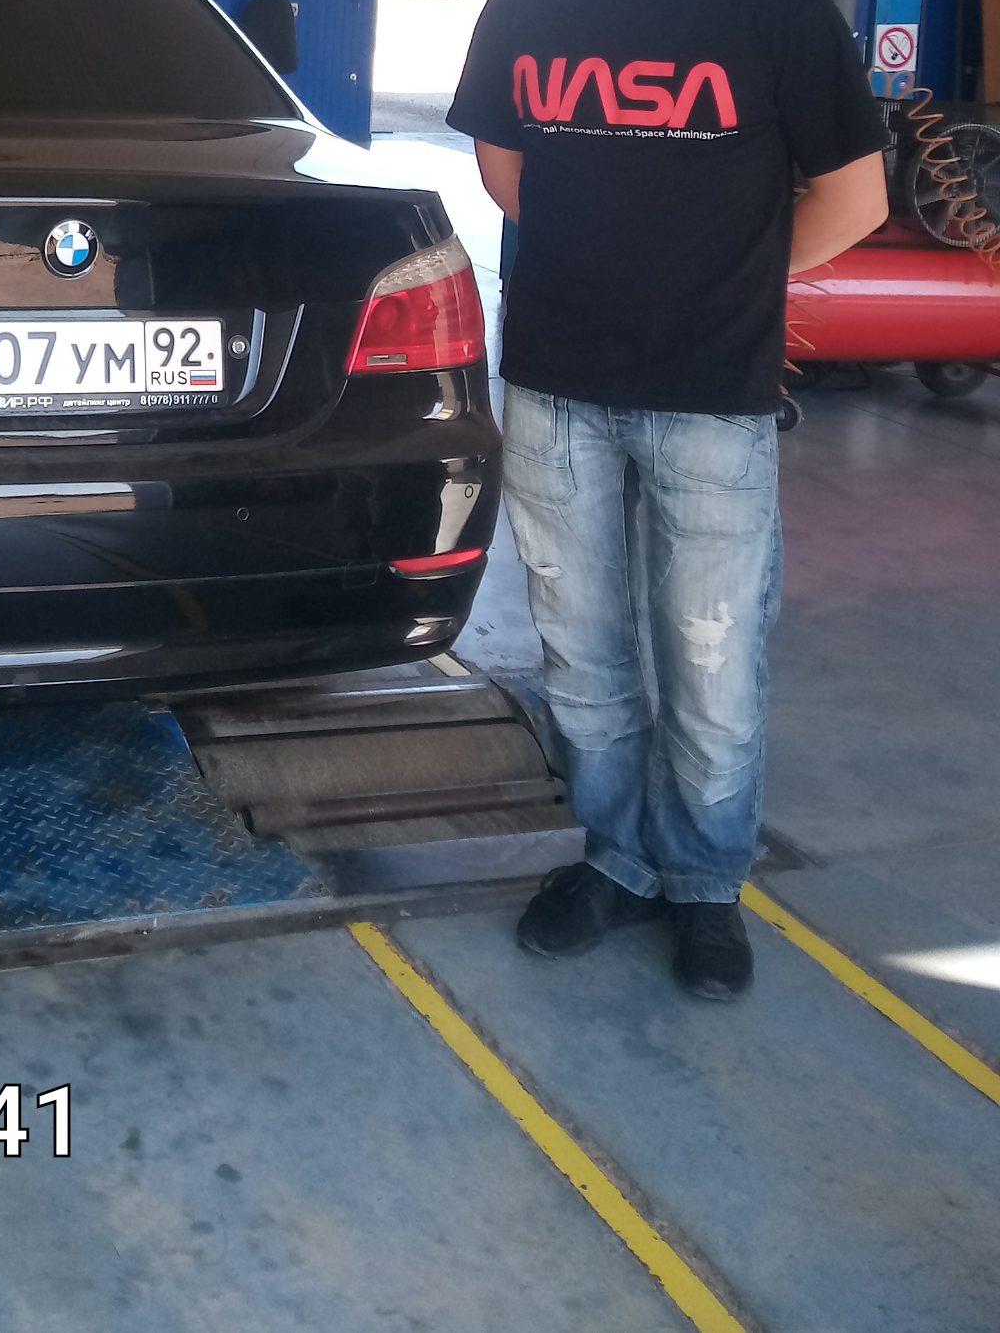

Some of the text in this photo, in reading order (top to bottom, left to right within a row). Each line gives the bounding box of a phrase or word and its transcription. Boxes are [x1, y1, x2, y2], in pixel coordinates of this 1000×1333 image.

[513, 54, 738, 128] NASA
[634, 128, 665, 139] Space
[152, 327, 202, 367] 92
[150, 370, 188, 386] RUS
[106, 398, 131, 407] центр
